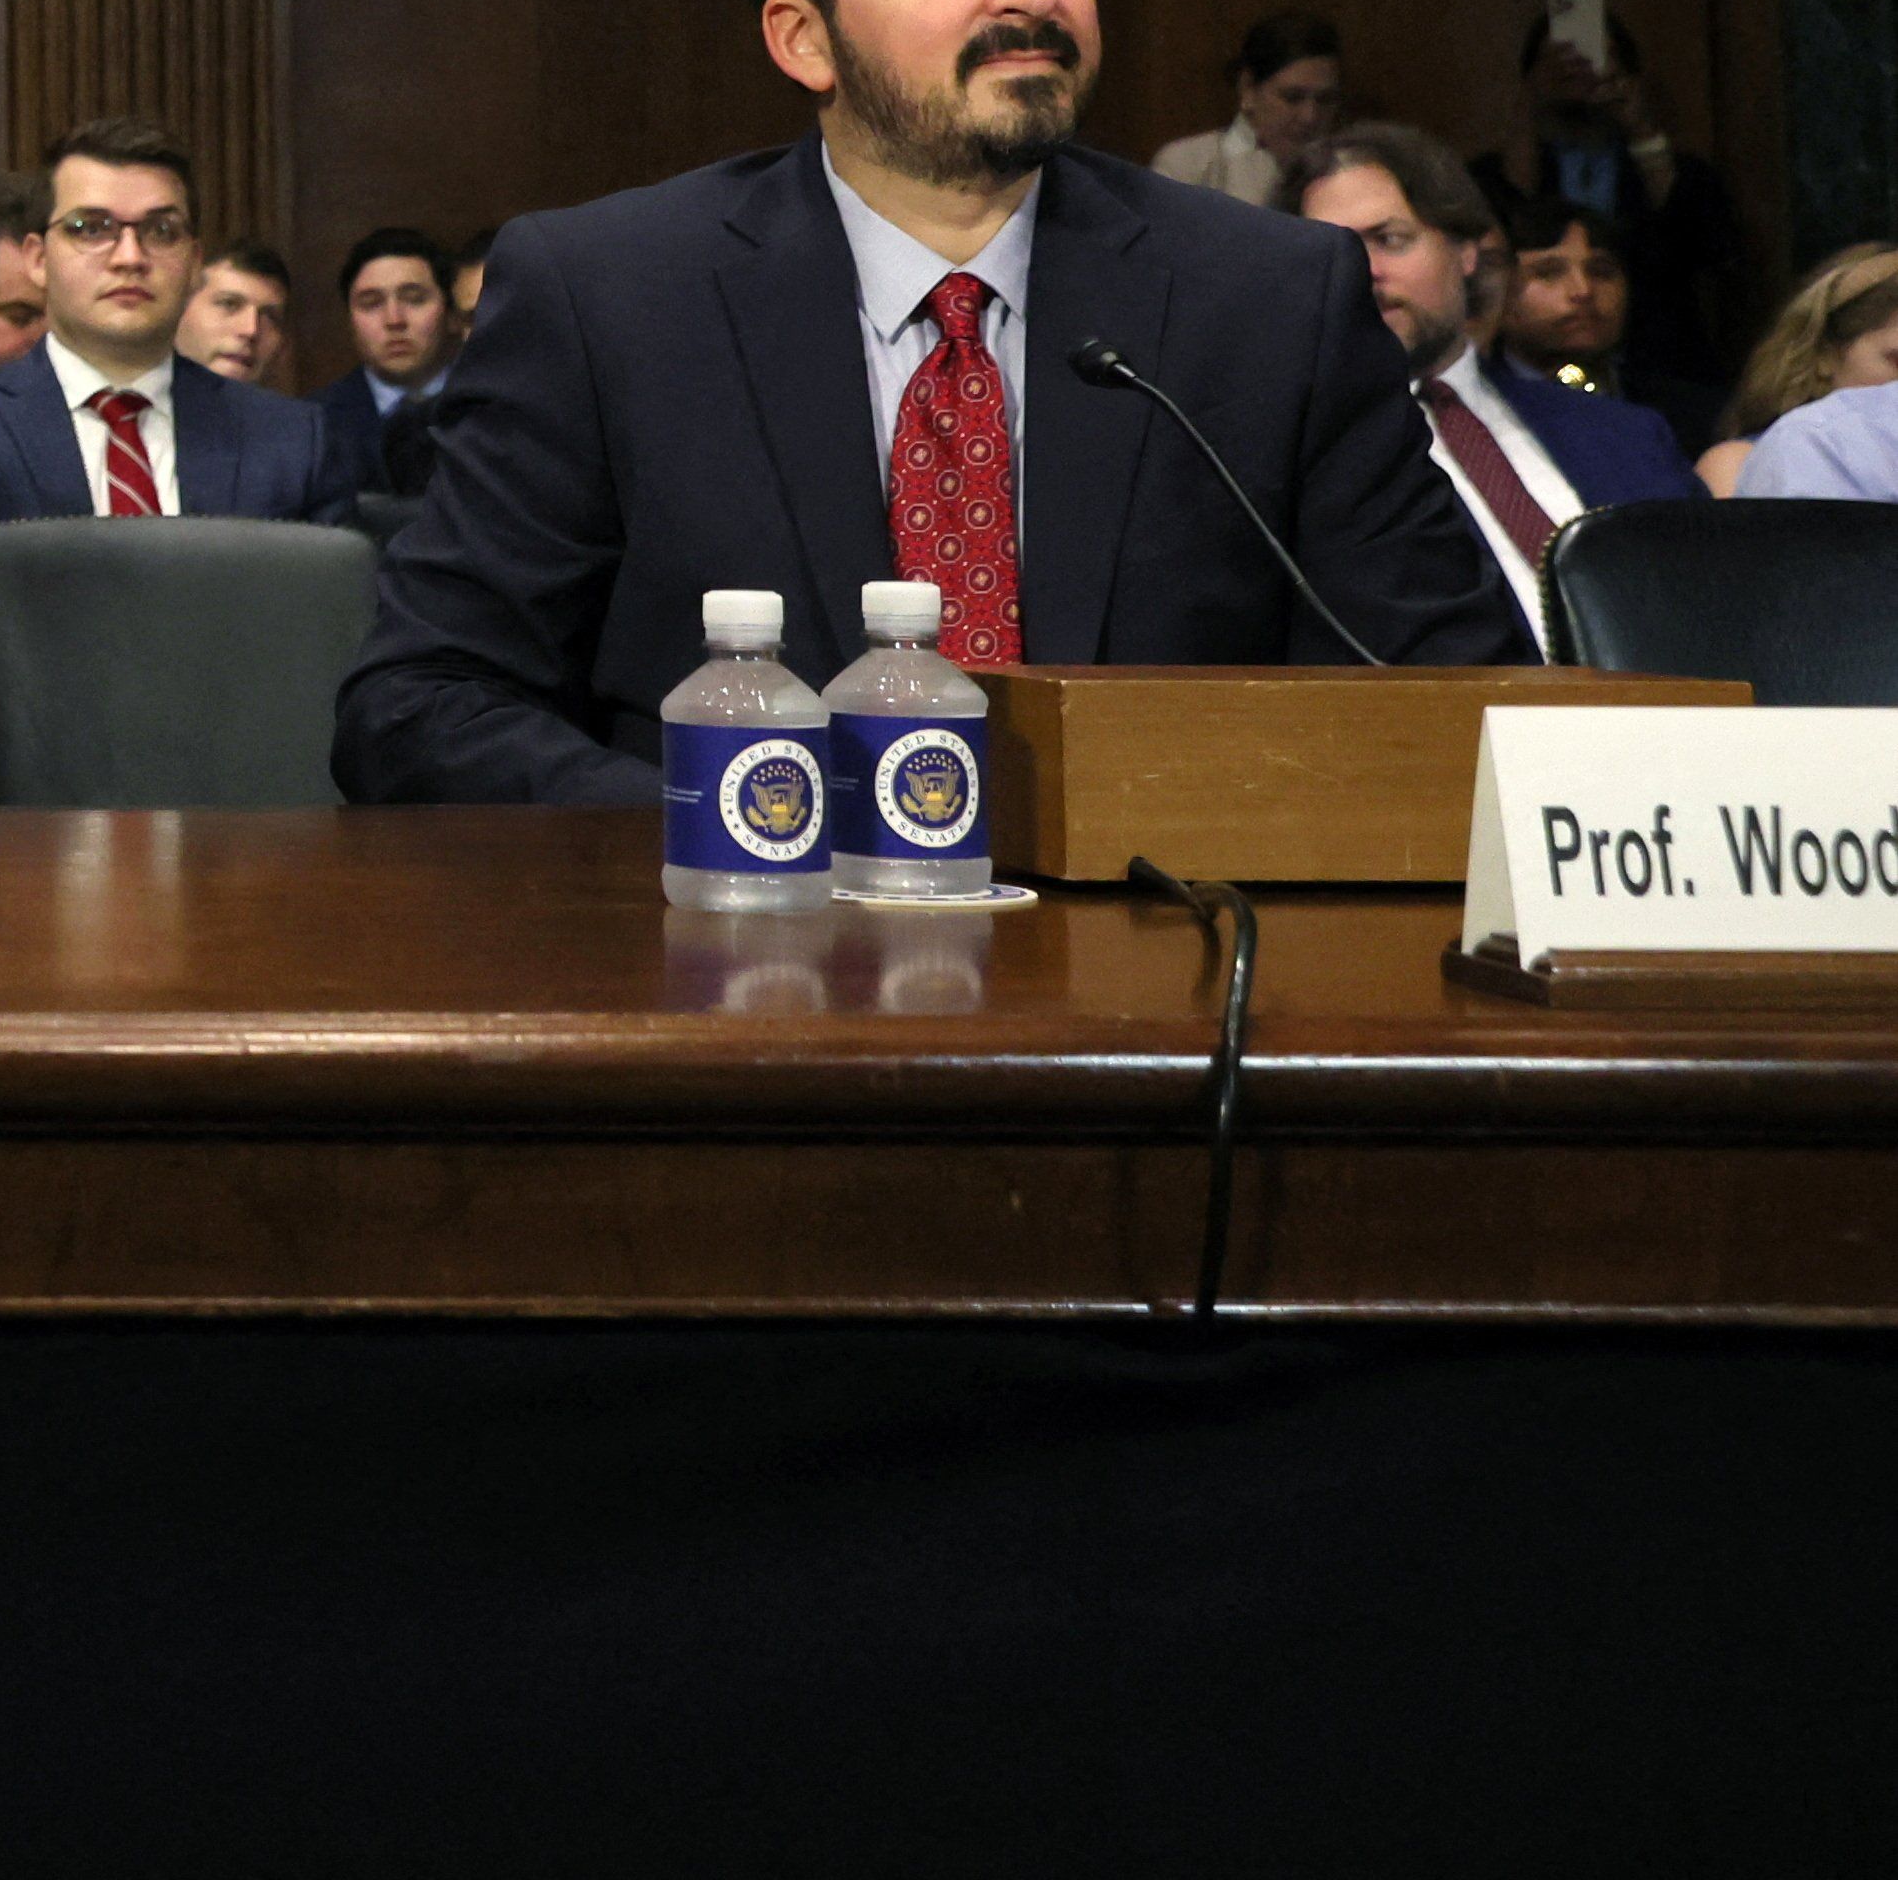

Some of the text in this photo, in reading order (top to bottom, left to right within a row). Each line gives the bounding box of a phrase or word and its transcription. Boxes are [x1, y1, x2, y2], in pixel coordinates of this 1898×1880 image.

[723, 744, 821, 803] UNITED STATES
[878, 733, 976, 790] UNITED STATES
[743, 833, 812, 857] SENATE
[897, 821, 967, 843] SENATE
[1541, 804, 1898, 898] Prof. Wood
